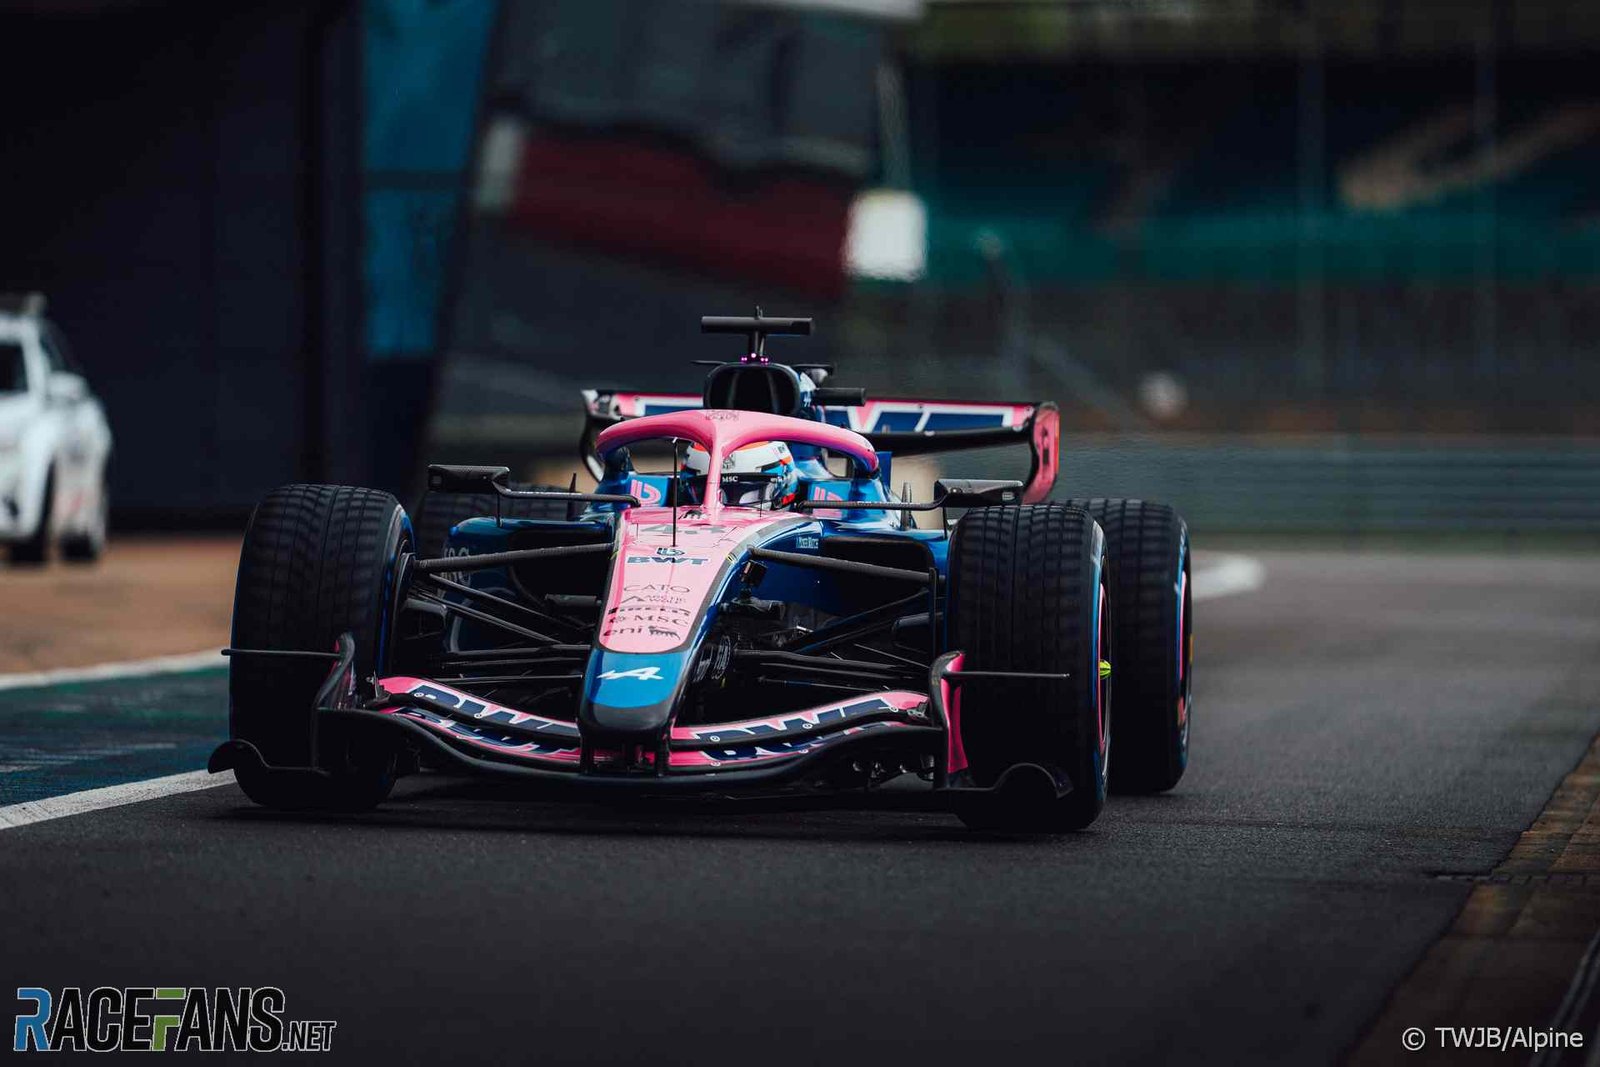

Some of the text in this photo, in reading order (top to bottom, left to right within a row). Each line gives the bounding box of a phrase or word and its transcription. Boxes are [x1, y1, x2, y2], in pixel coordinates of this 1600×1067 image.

[627, 556, 709, 565] BWT
[624, 584, 690, 593] CATO
[634, 615, 689, 627] MSC
[603, 626, 643, 637] eni
